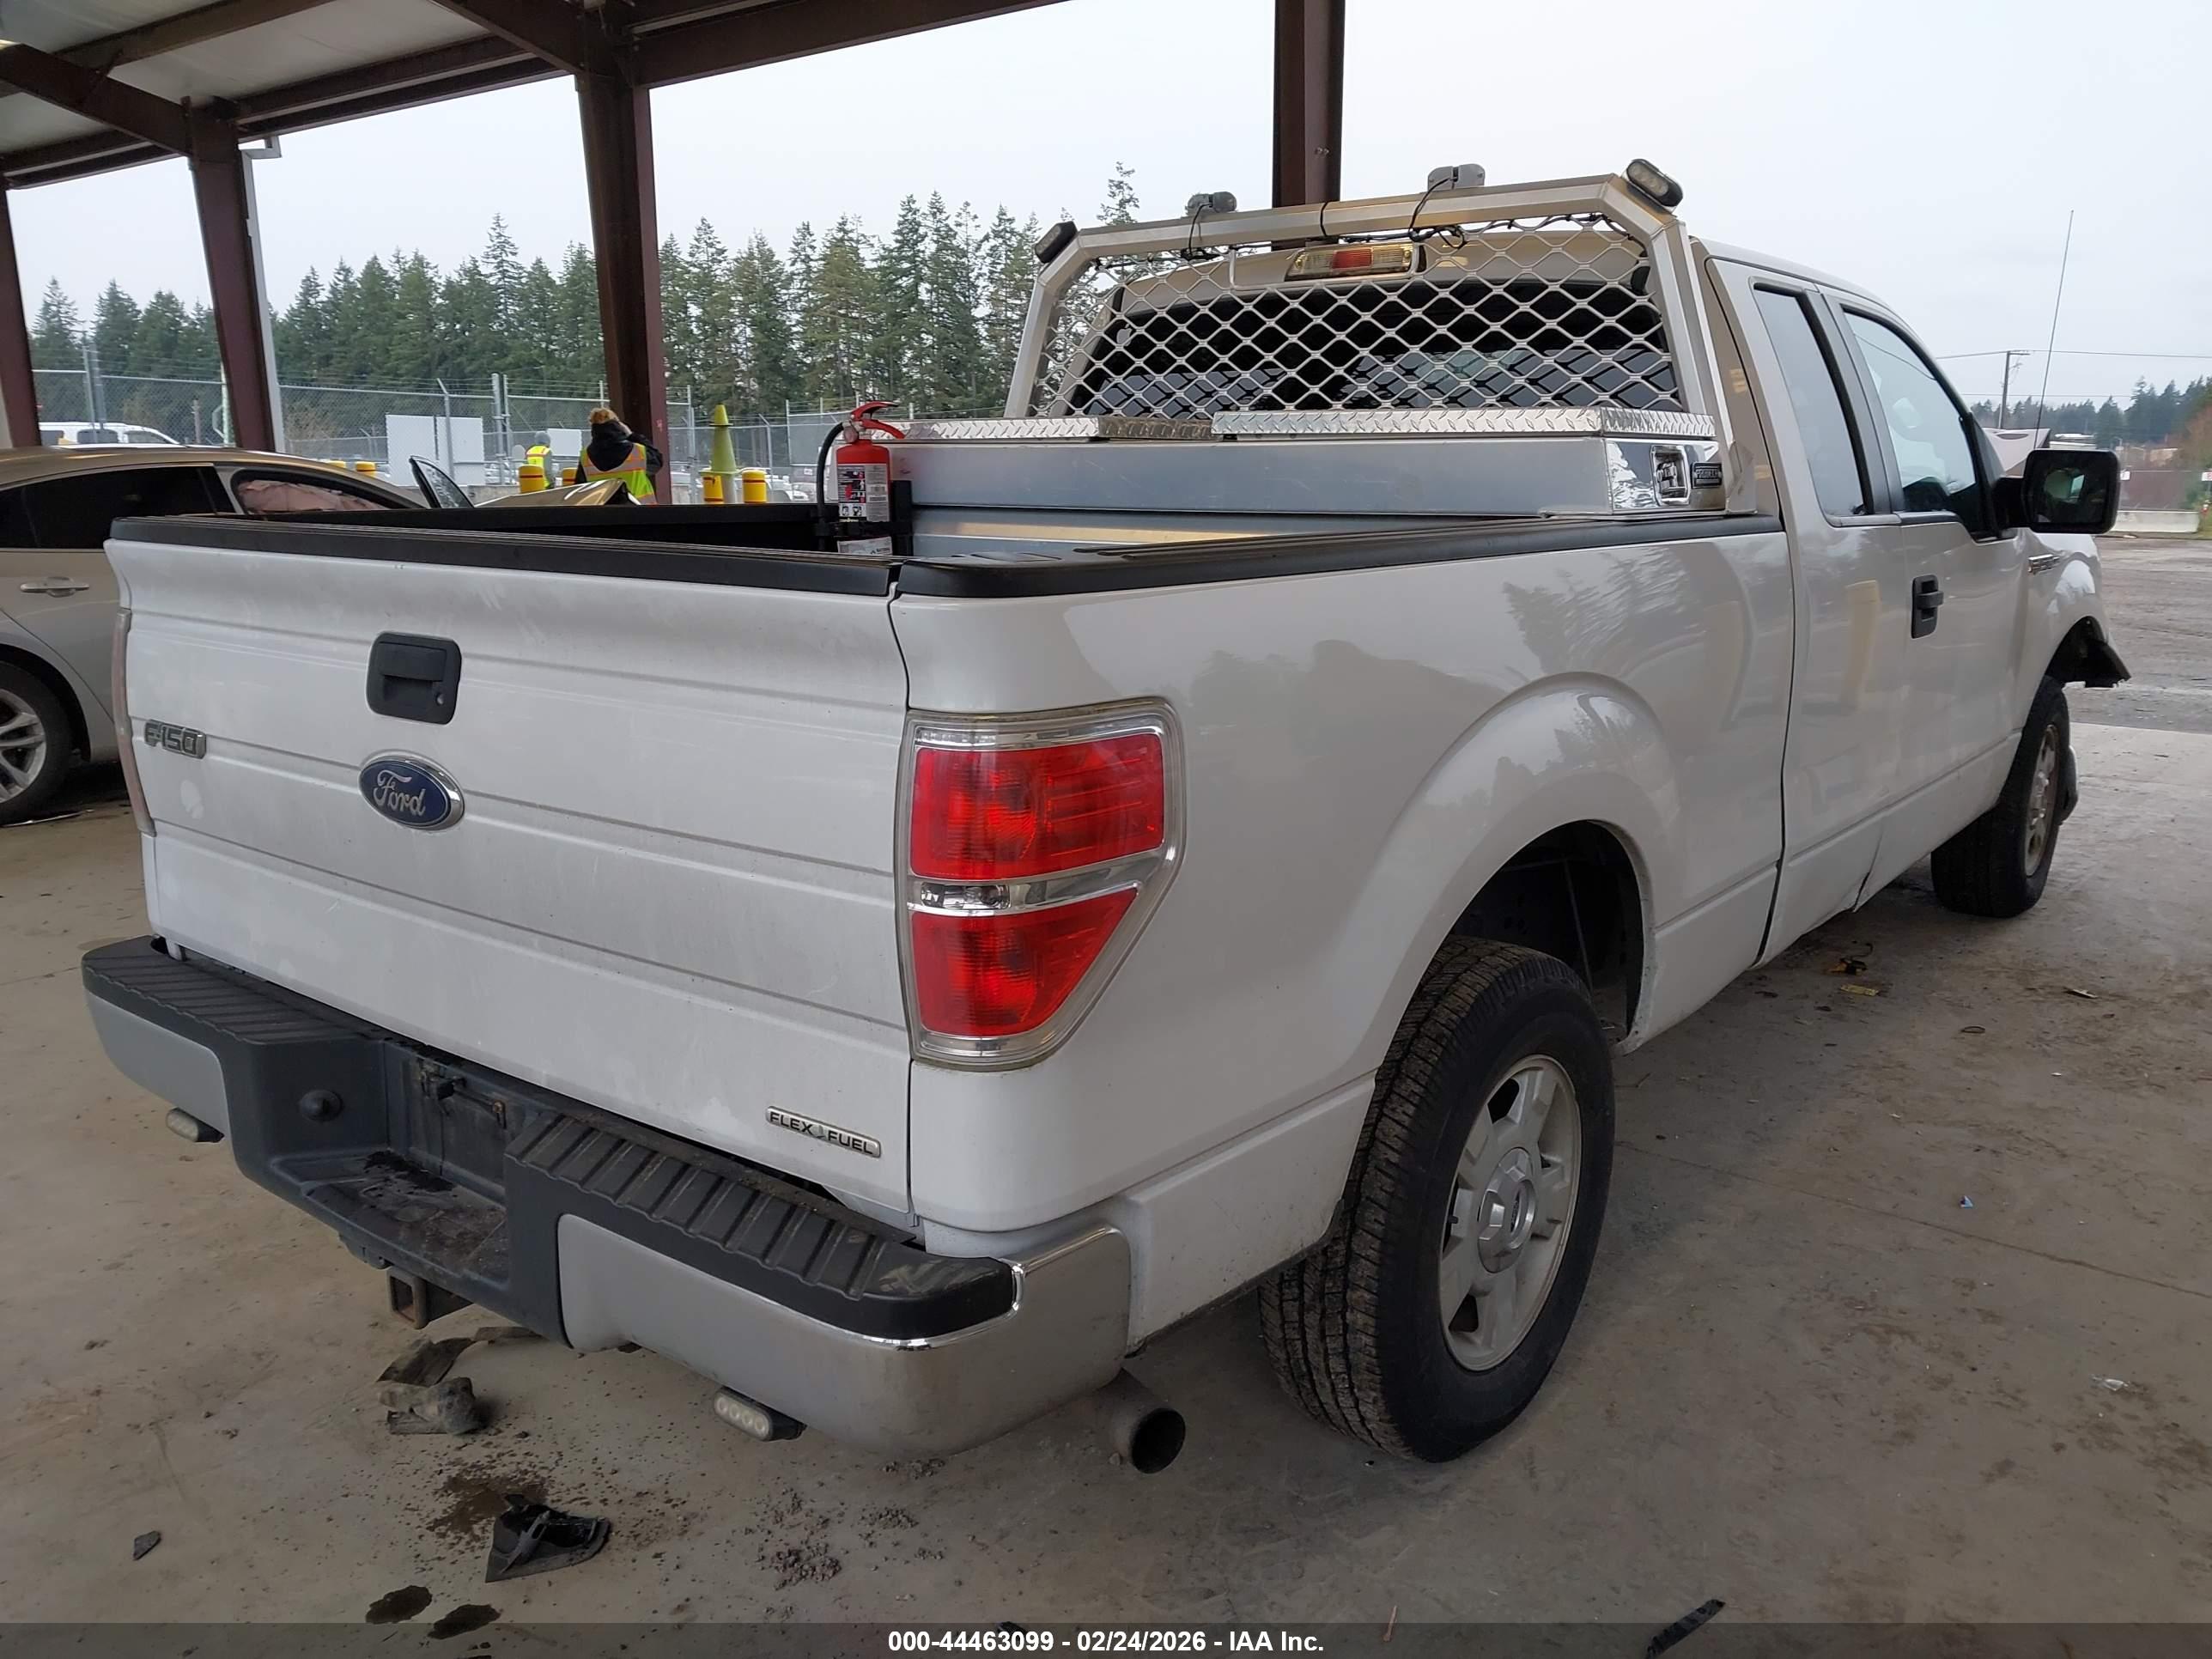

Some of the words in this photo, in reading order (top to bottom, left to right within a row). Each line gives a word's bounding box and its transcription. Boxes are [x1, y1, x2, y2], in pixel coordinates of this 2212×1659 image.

[144, 720, 204, 758] F-150
[373, 769, 434, 817] Ford
[770, 1112, 813, 1136] FLEX
[829, 1131, 874, 1155] FUEL
